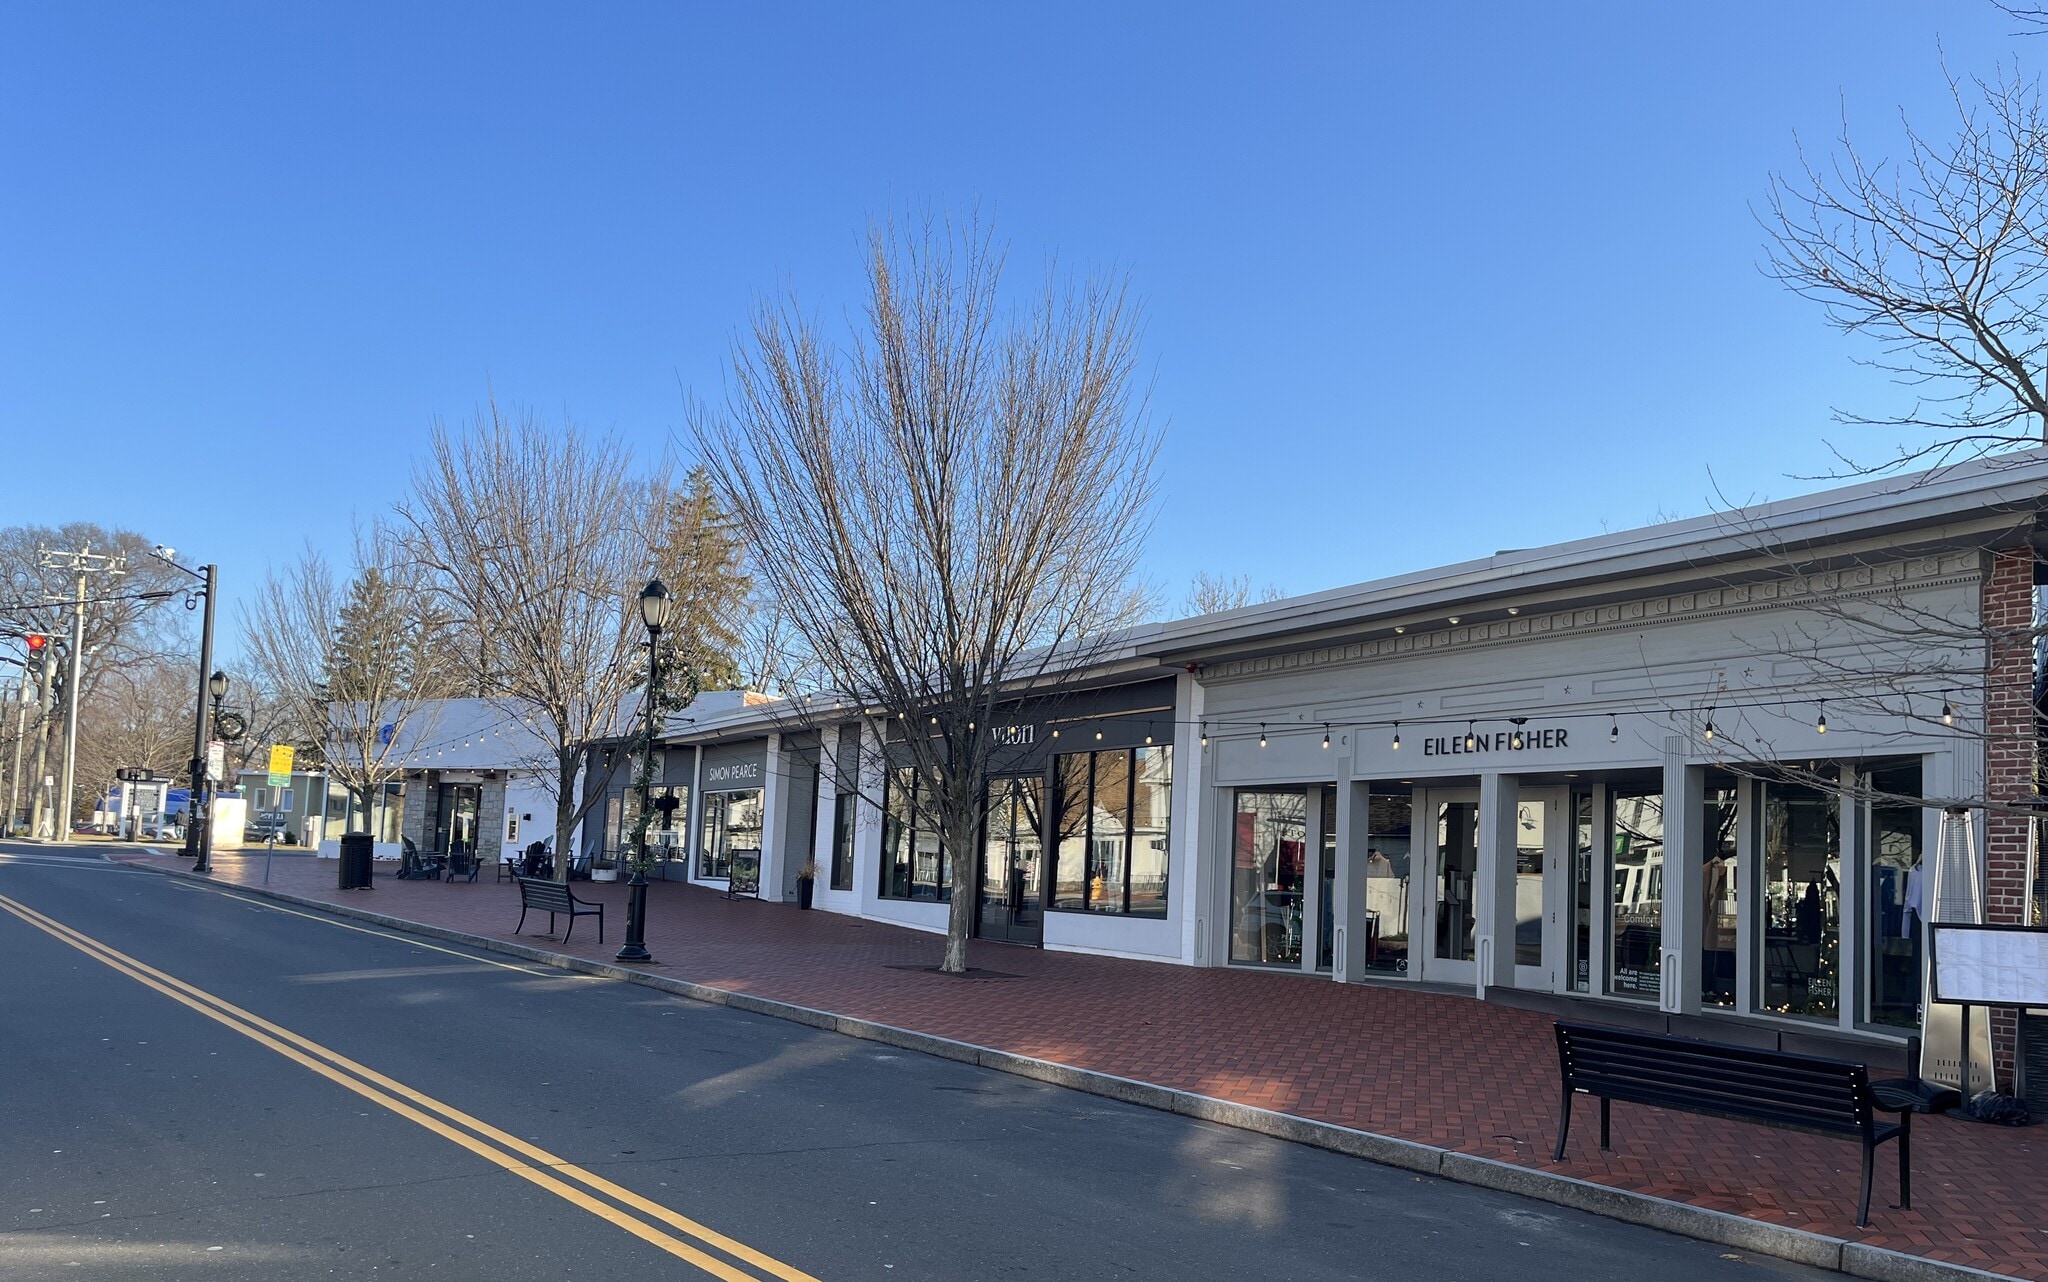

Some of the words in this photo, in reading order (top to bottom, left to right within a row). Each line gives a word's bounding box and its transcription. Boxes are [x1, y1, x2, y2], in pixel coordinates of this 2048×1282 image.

[1424, 733, 1489, 756] EILEEN
[1495, 728, 1568, 751] FISHER
[709, 766, 730, 781] SIMON
[731, 763, 758, 779] PEARCE
[1619, 967, 1628, 975] All
[1807, 987, 1832, 996] FISHER
